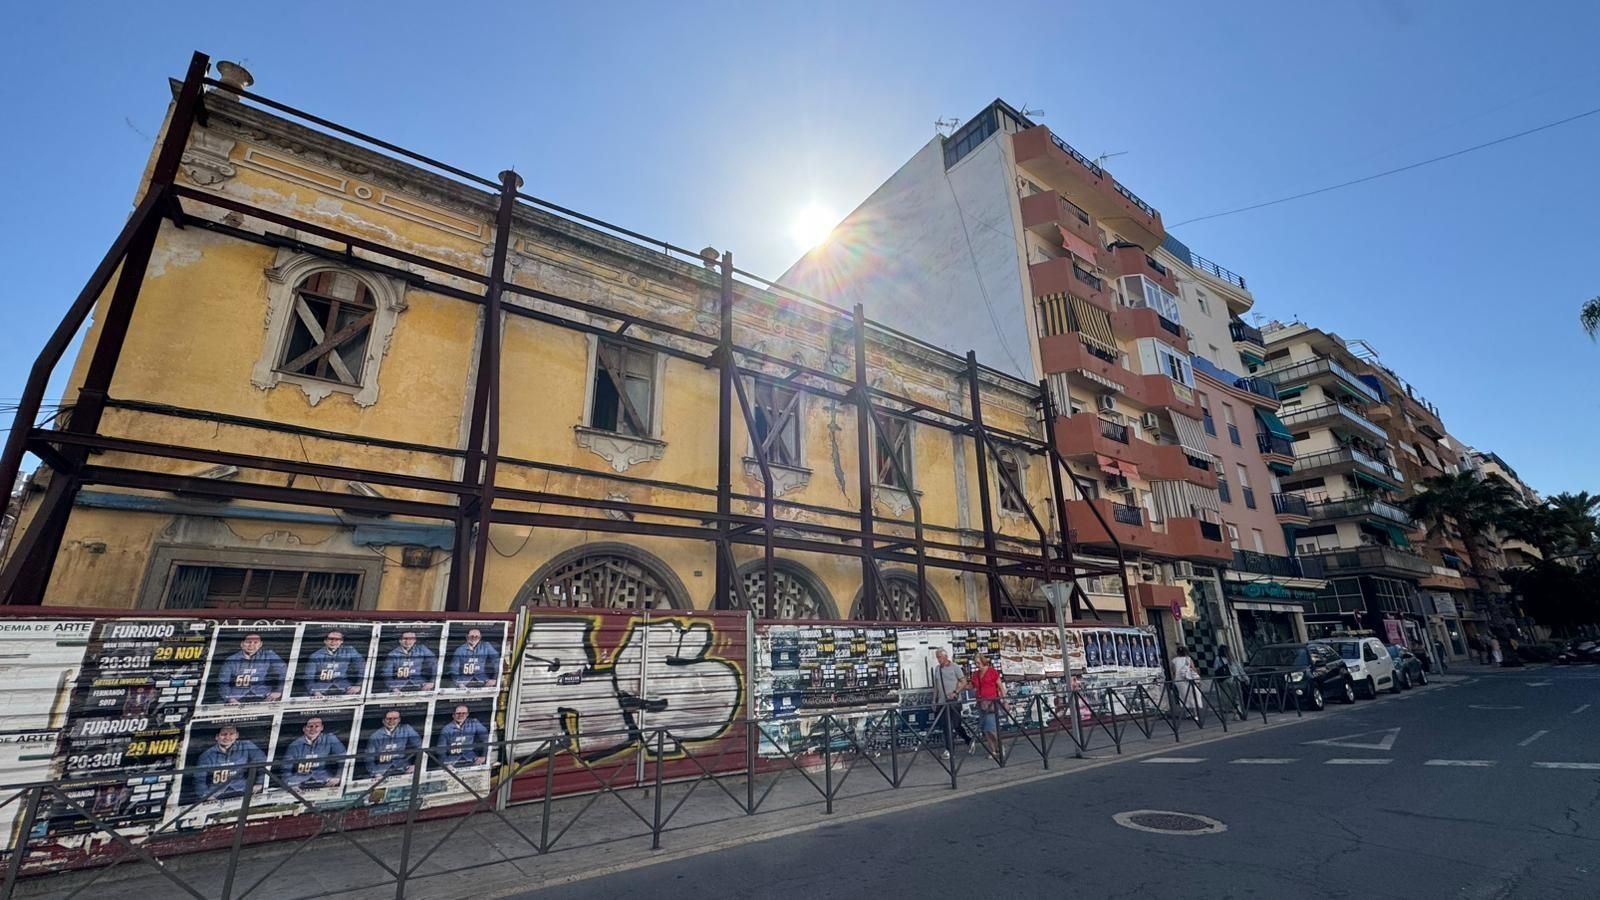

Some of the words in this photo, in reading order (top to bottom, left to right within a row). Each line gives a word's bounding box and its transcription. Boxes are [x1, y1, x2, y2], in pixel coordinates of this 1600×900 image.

[35, 624, 50, 632] DE
[53, 622, 91, 632] ARTE
[111, 624, 175, 638] FURRUCO
[153, 647, 173, 660] 29
[174, 646, 203, 660] NOV
[99, 655, 151, 669] 20:30H
[98, 698, 116, 706] SOTO
[81, 718, 149, 736] FURRUCO
[16, 734, 56, 742] ARTE
[125, 742, 147, 757] 29
[148, 740, 178, 755] NOV
[67, 752, 123, 770] 20:30H
